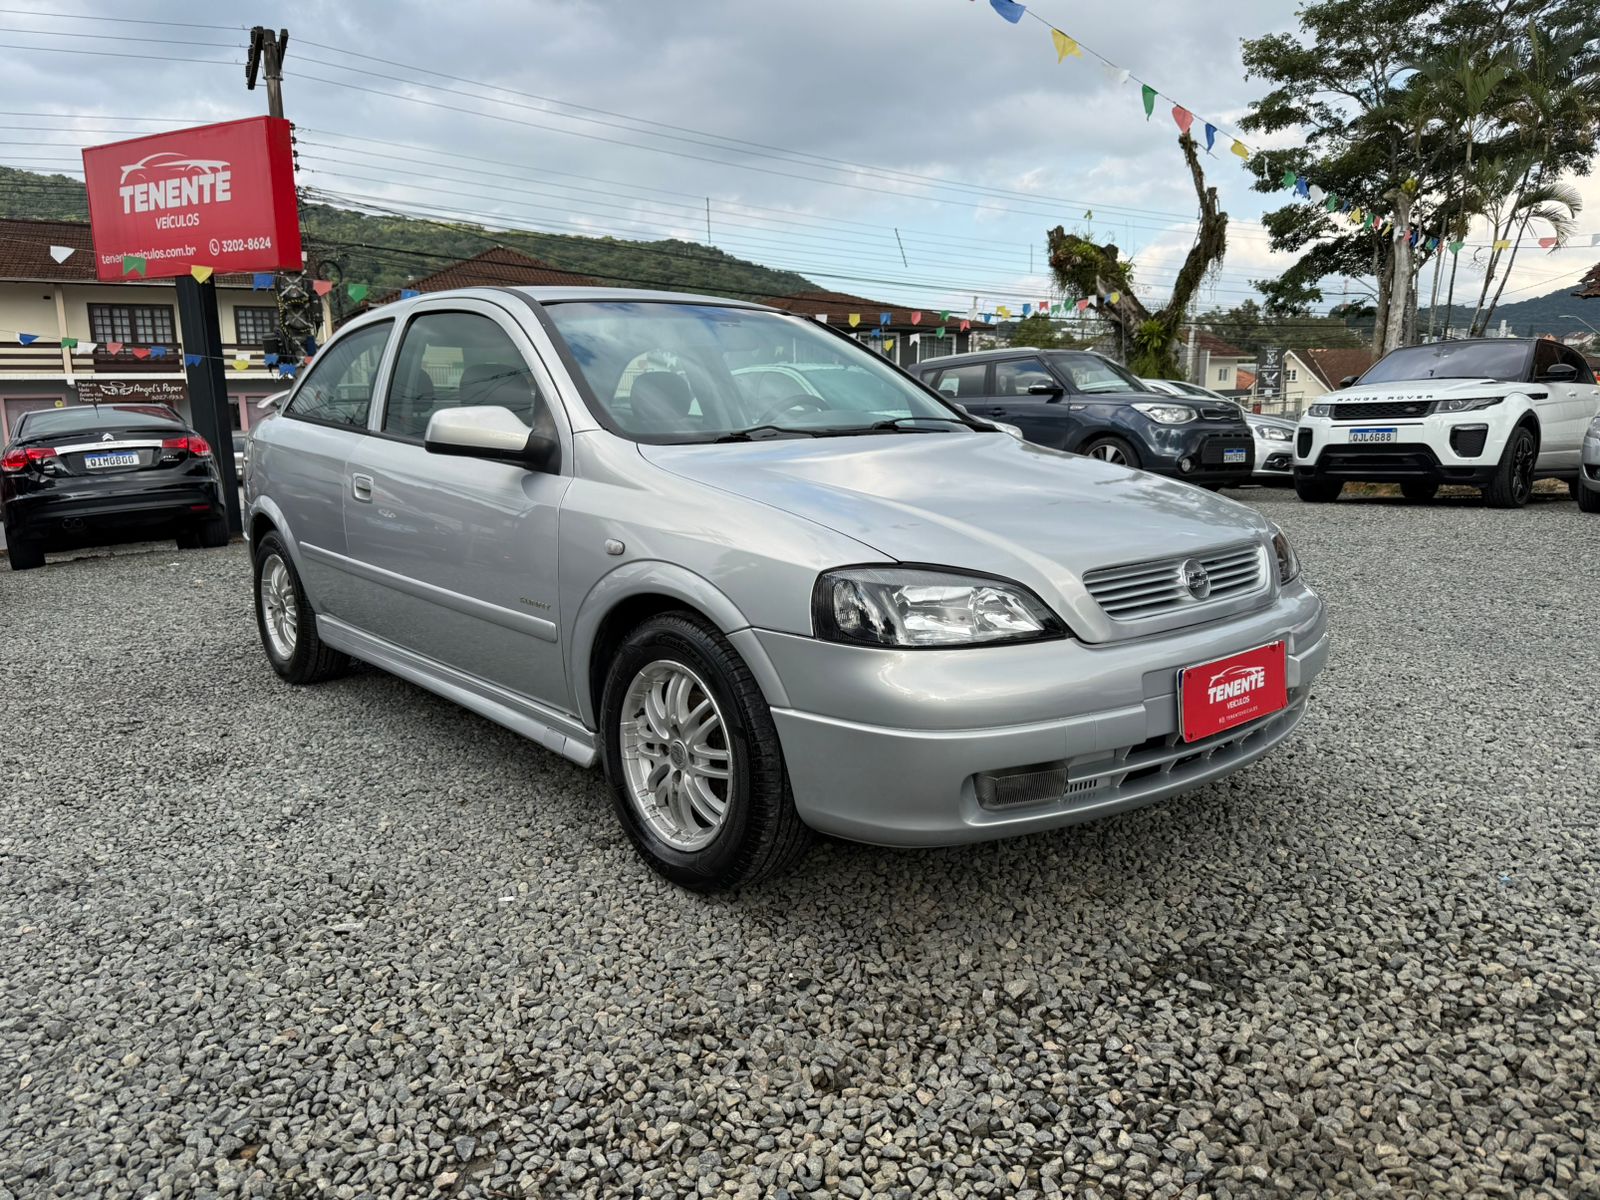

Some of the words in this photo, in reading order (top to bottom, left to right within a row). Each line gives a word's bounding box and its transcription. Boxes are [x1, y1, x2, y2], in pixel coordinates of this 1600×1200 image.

[119, 172, 231, 214] TENENTE
[155, 213, 200, 230] VEÍCULOS
[221, 236, 272, 253] 3202-8624
[133, 383, 161, 397] Angel's
[162, 382, 182, 394] Paper
[1352, 433, 1392, 442] QJL6G88
[1208, 671, 1264, 704] TENENTE
